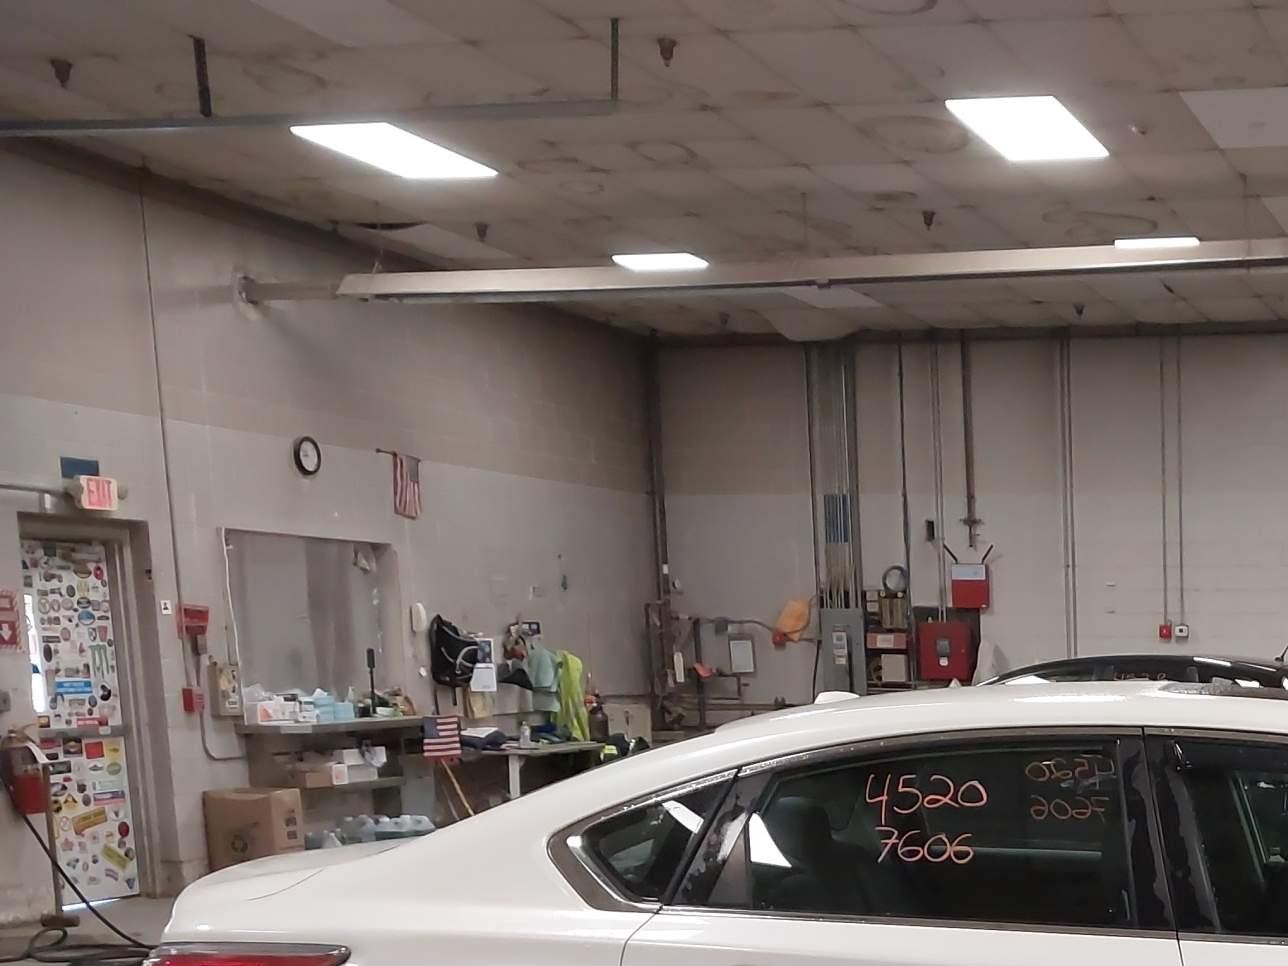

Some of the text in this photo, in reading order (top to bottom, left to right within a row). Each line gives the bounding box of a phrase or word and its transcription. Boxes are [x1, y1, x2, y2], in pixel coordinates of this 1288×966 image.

[86, 479, 112, 506] EXIT
[866, 774, 988, 825] 4520
[874, 826, 974, 864] 7606
